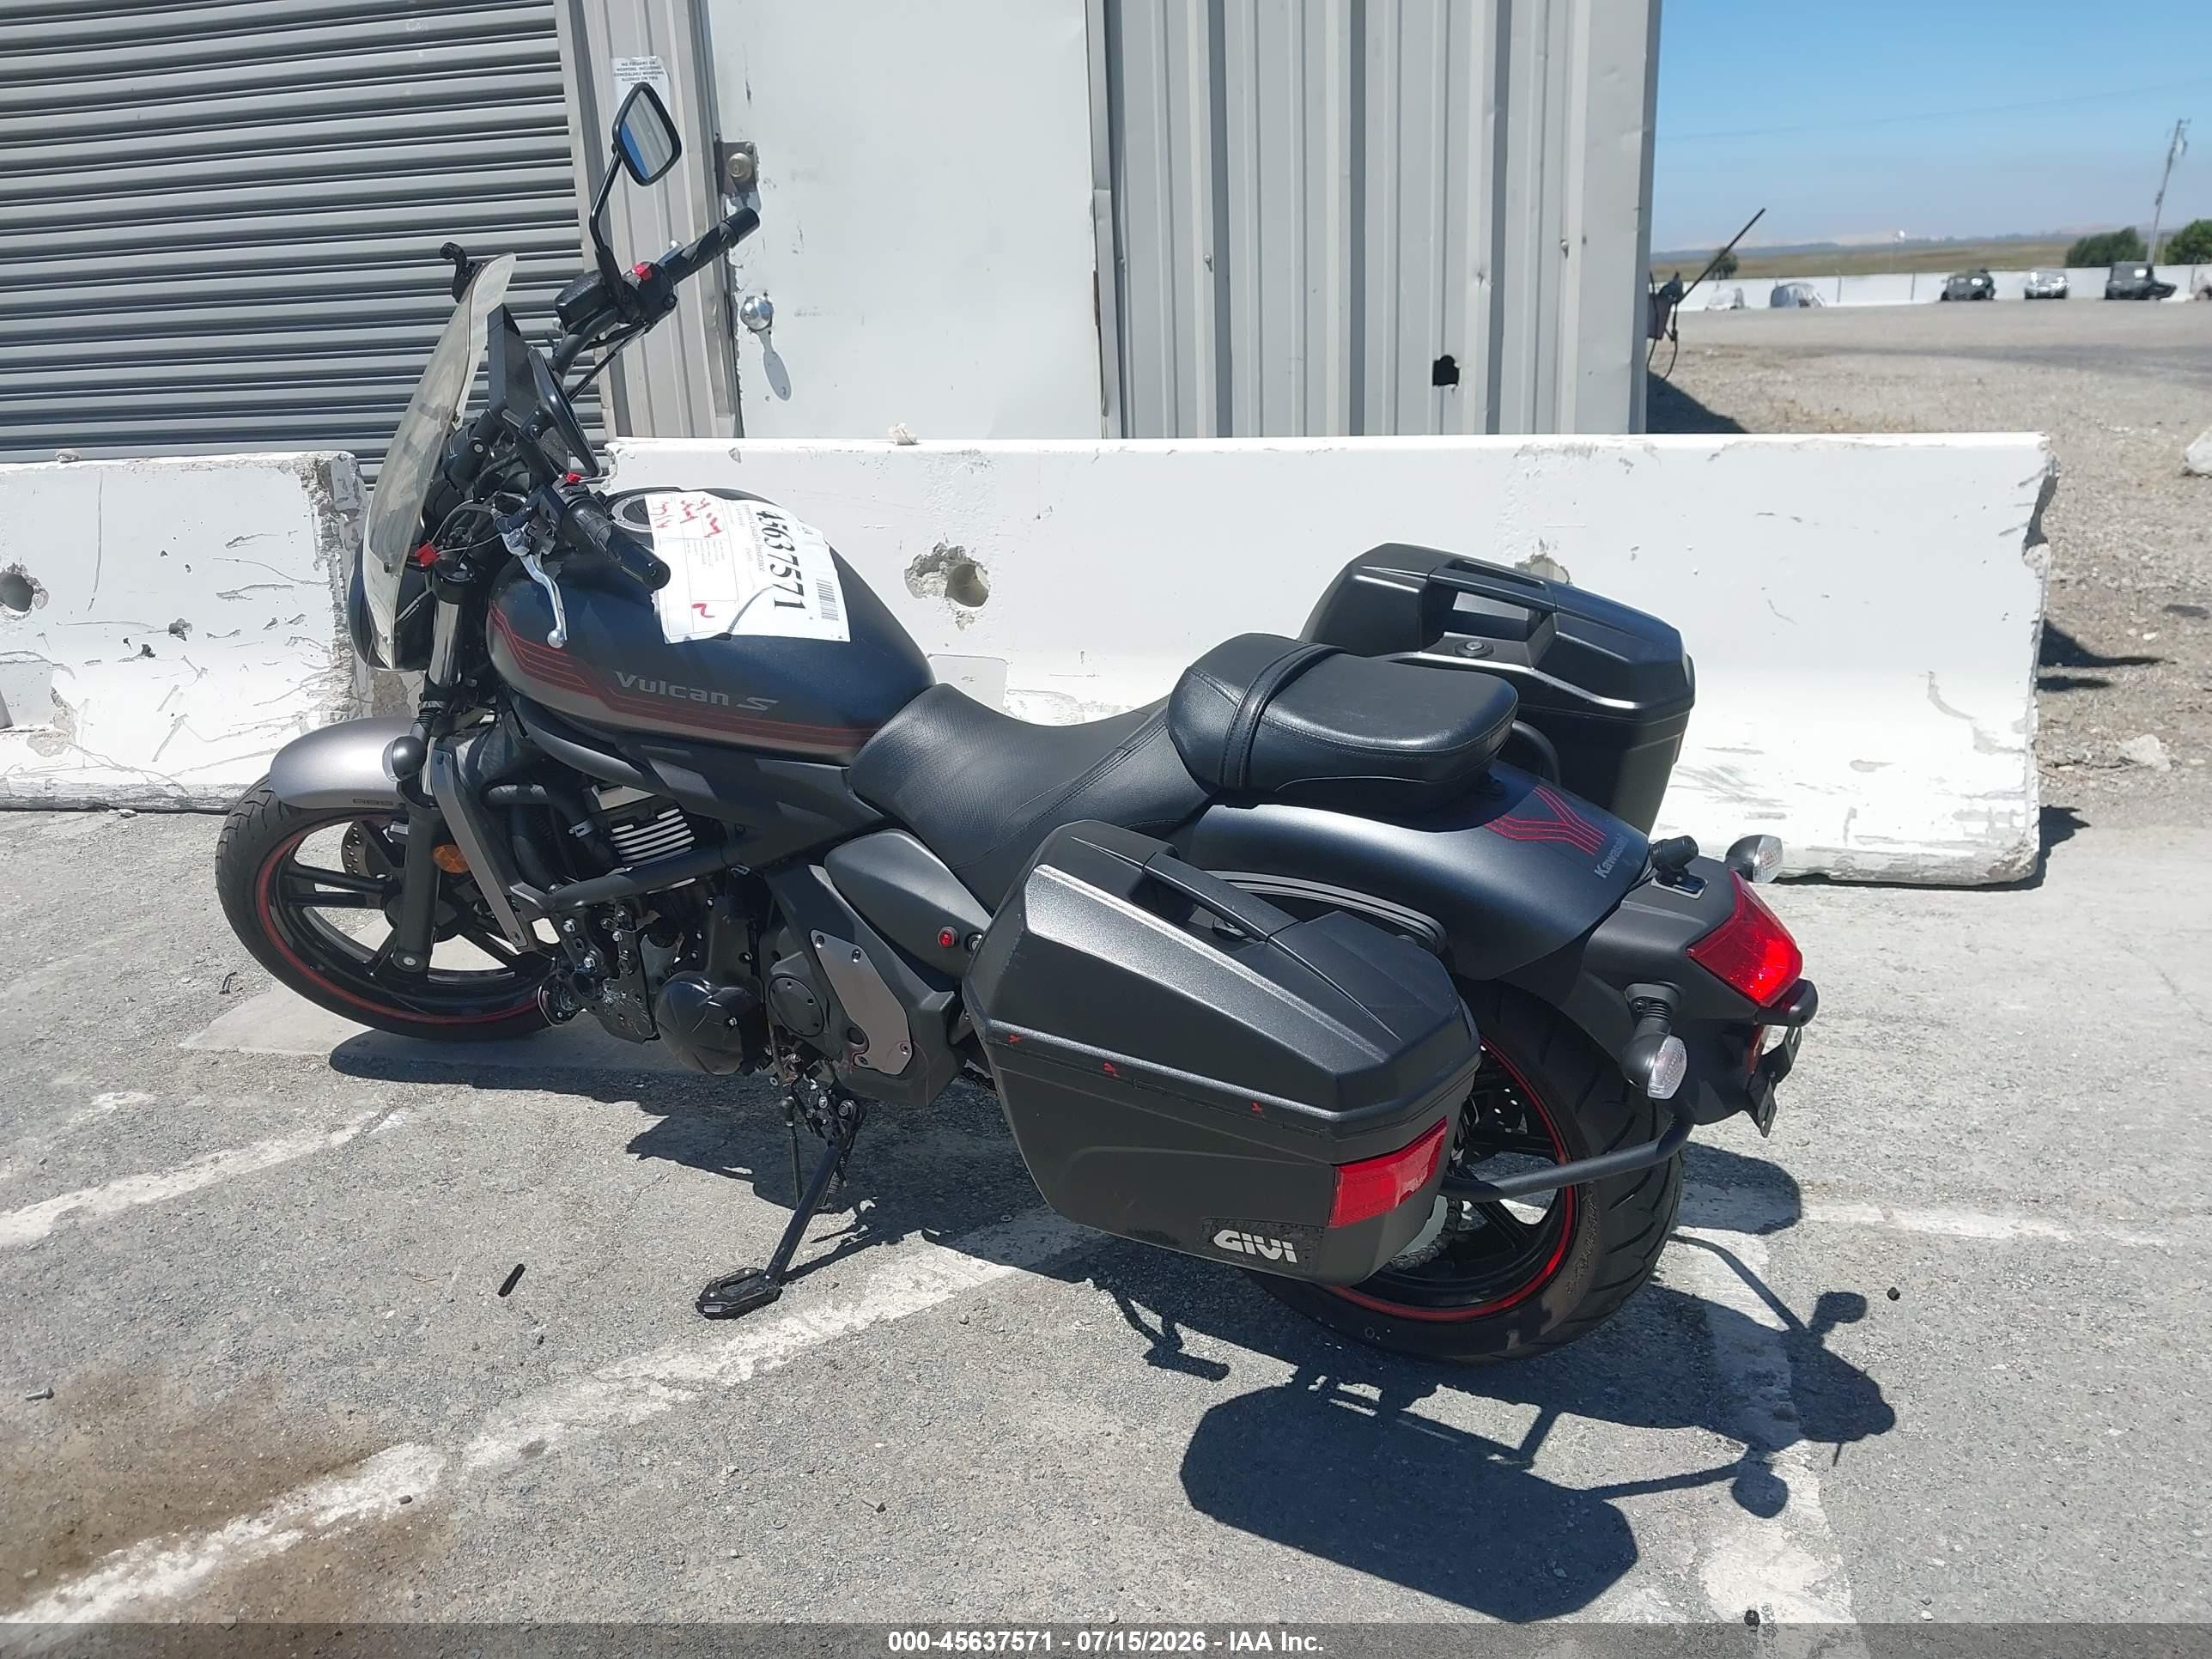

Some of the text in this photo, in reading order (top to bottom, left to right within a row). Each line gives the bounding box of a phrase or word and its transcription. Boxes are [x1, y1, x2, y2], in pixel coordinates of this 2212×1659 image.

[756, 510, 806, 611] 45637571
[615, 671, 780, 712] Vulcan S
[1213, 1229, 1297, 1263] GIVI
